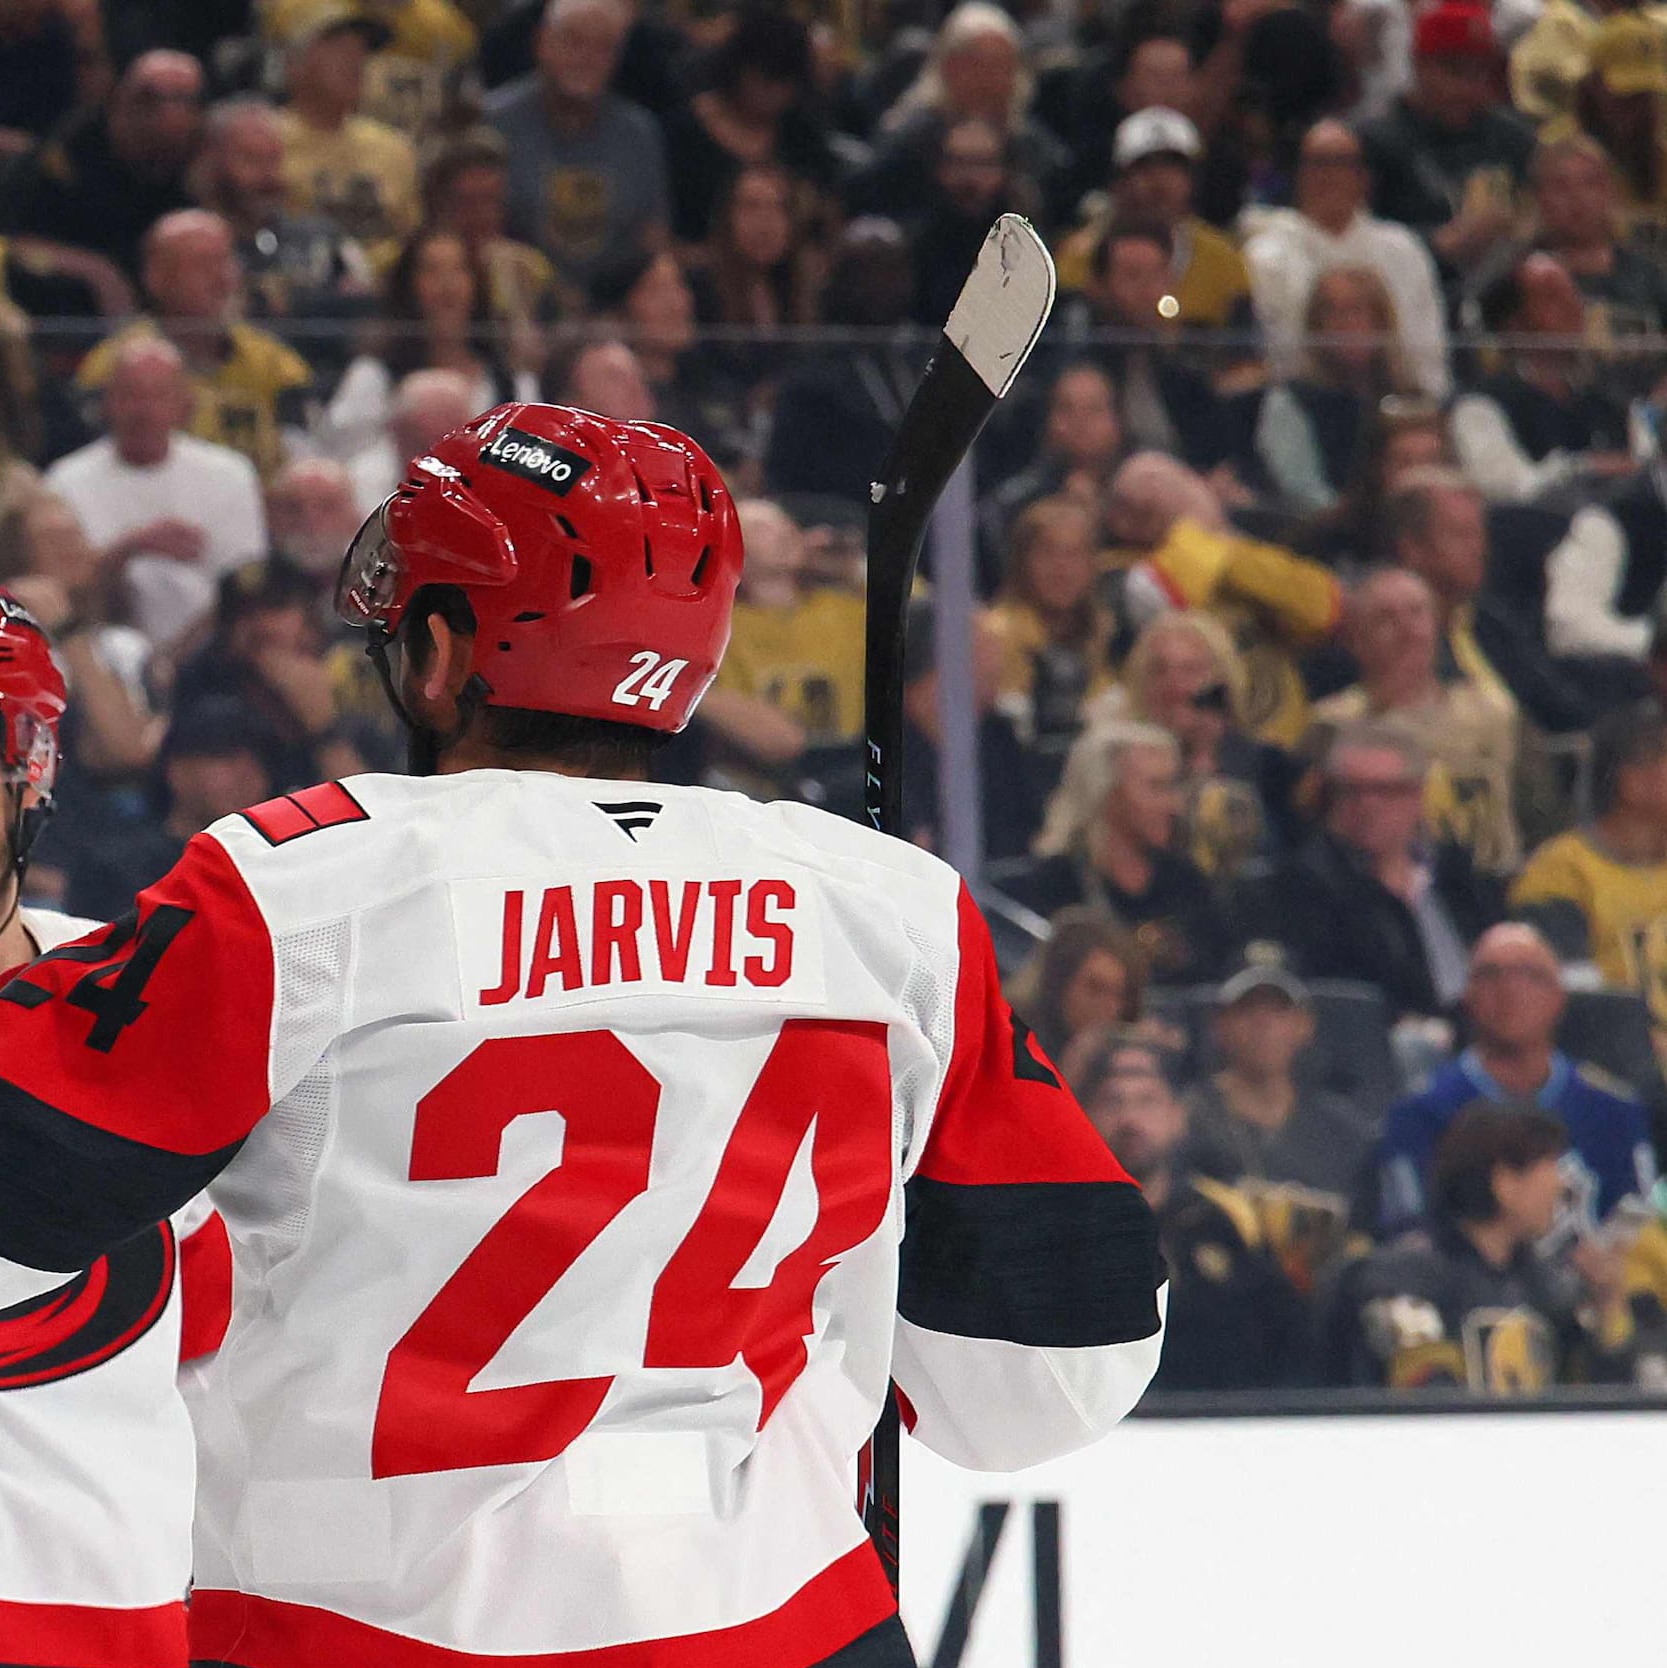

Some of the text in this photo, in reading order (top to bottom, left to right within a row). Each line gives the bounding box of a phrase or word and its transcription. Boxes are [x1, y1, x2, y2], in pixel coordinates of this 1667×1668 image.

[489, 433, 571, 482] Lenovo
[610, 649, 691, 712] 24
[866, 737, 881, 833] FLY
[479, 878, 797, 1007] JARVIS
[371, 1018, 890, 1482] 24
